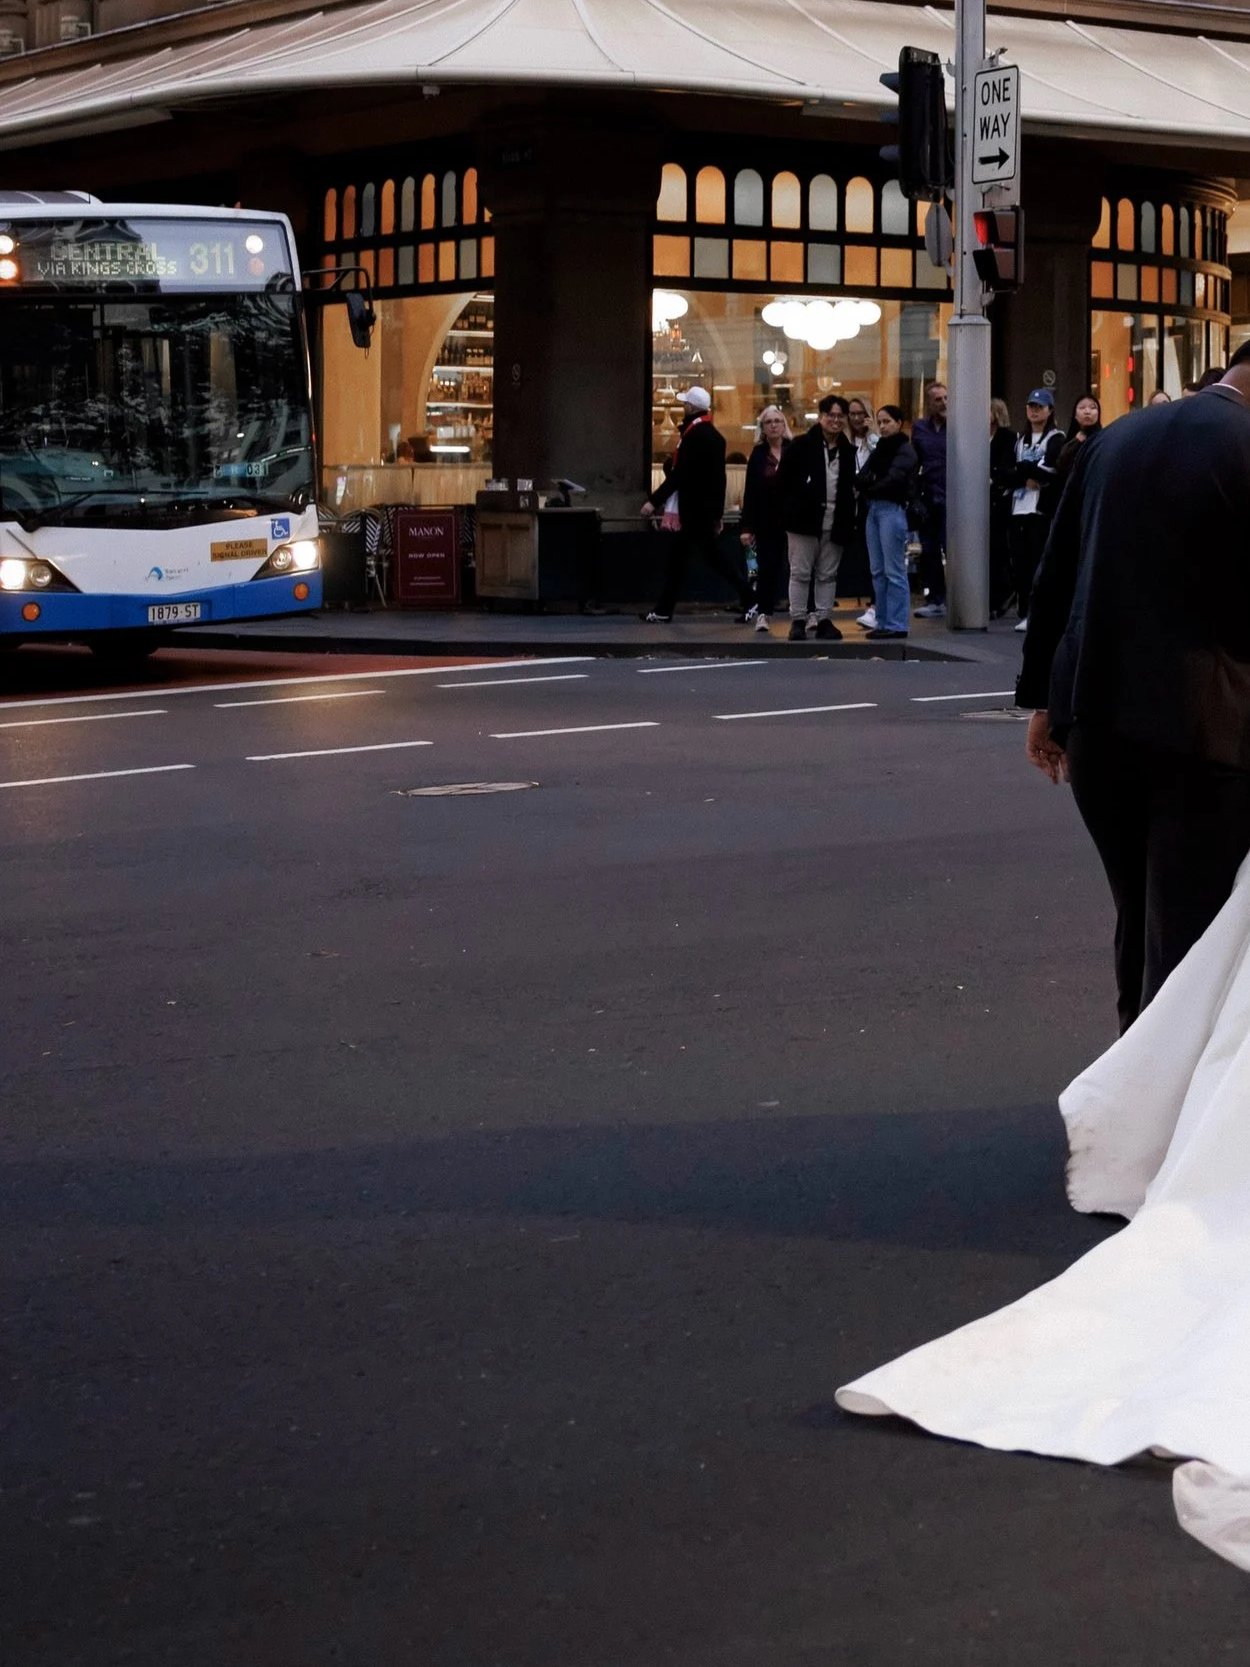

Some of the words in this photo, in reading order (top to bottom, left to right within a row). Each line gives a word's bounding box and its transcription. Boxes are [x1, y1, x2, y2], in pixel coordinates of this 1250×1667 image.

[981, 77, 1011, 106] ONE
[980, 112, 1011, 141] WAY
[38, 261, 66, 275] VIA
[71, 261, 121, 275] KINGS
[126, 261, 177, 275] CROSS
[50, 242, 166, 261] CENTRAL
[189, 243, 235, 275] 311
[409, 526, 444, 537] MANON
[225, 540, 252, 550] PLEASE
